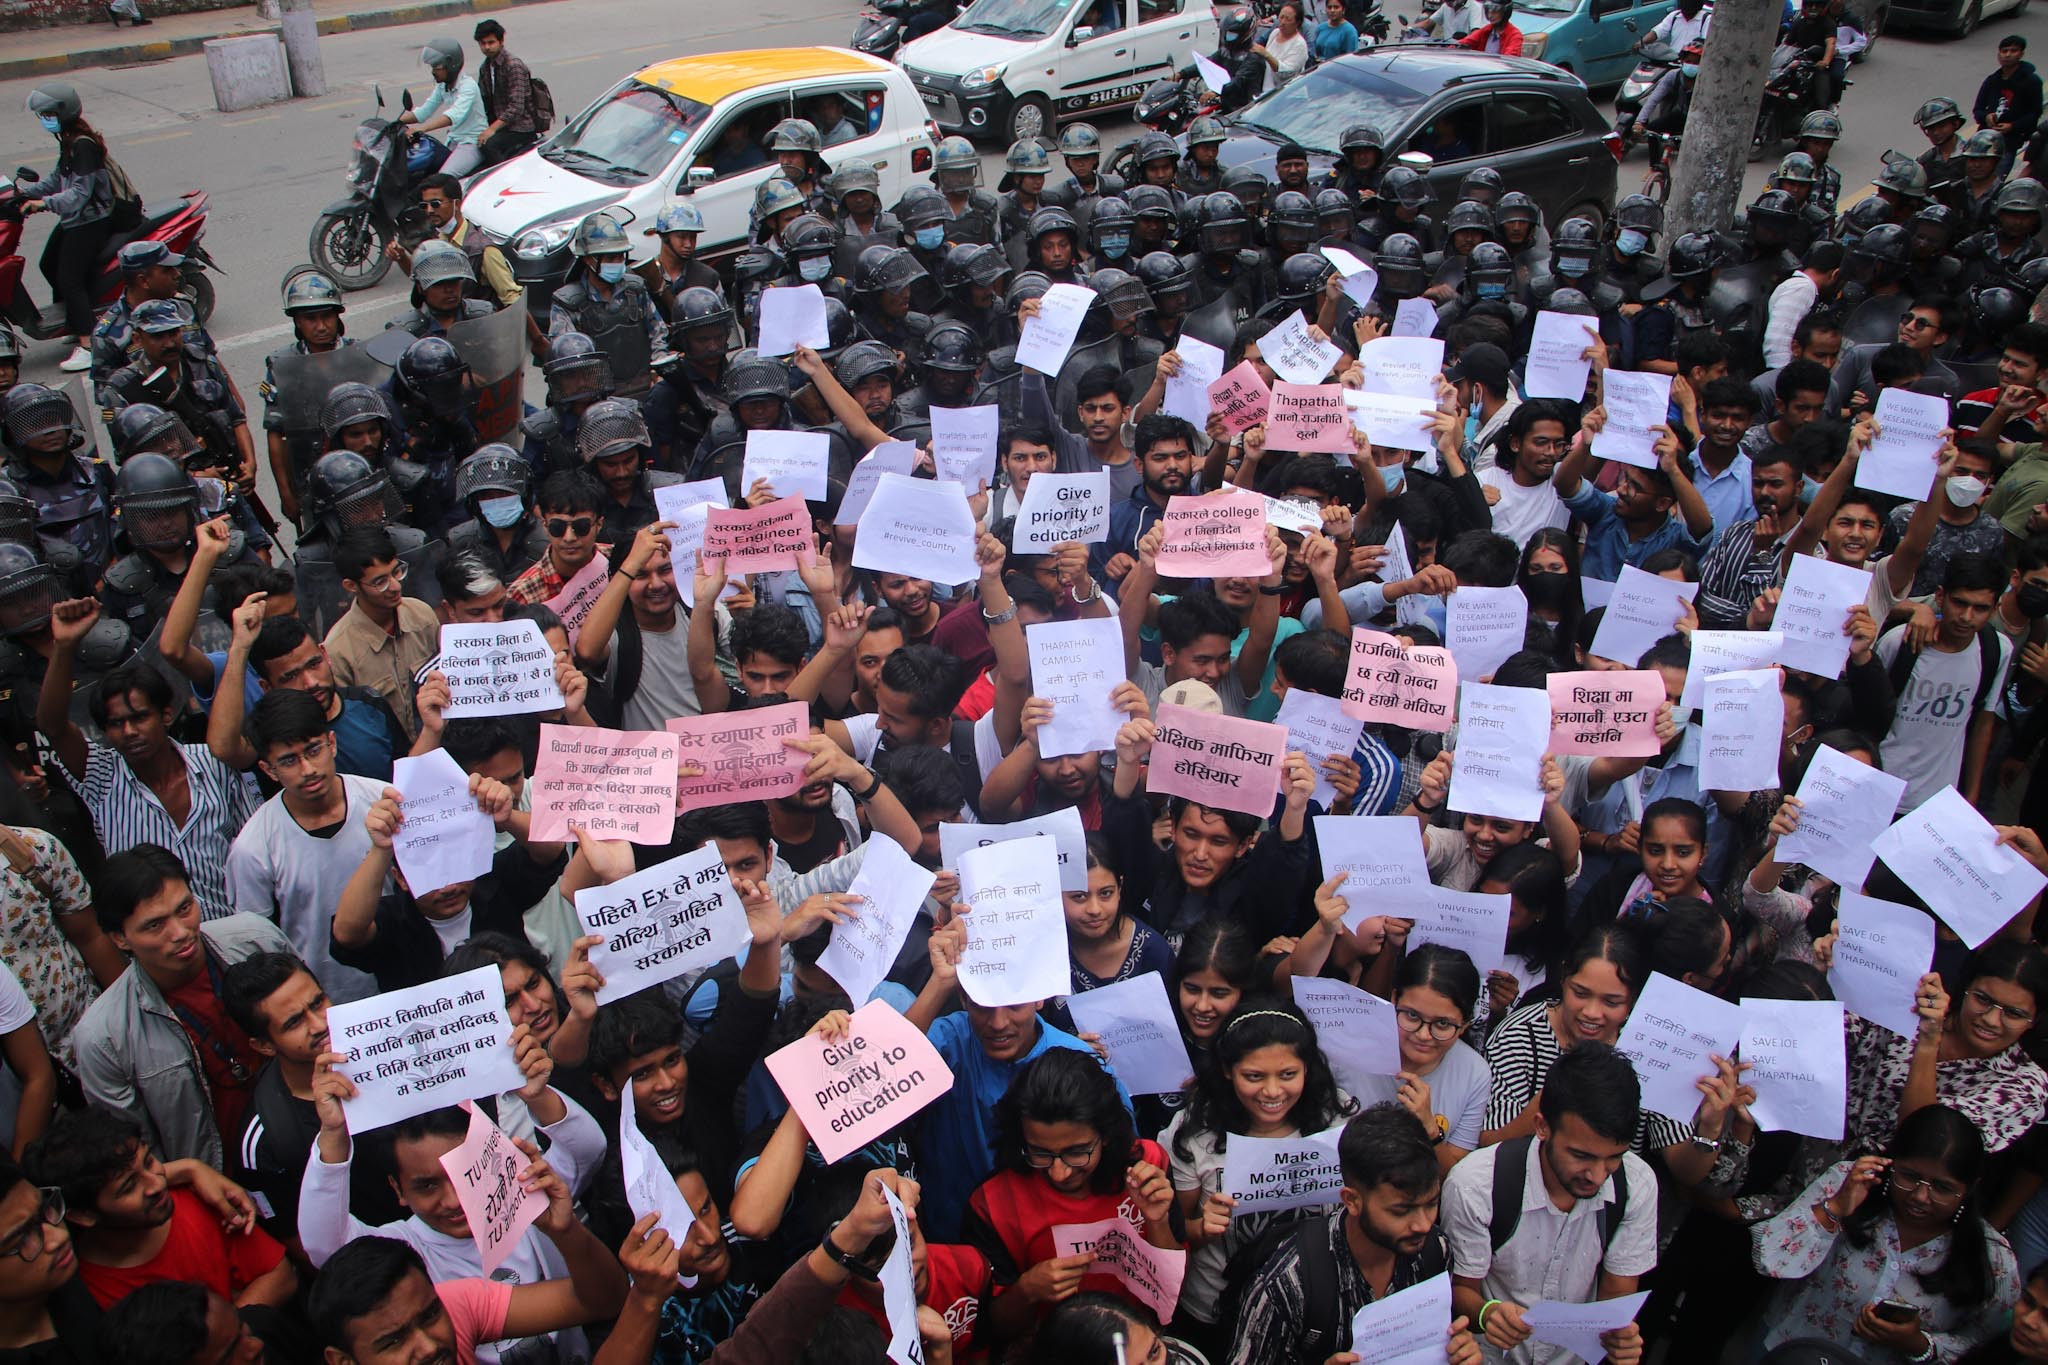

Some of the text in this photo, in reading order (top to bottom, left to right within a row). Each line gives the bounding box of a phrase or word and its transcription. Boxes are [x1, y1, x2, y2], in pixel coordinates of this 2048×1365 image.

[1290, 322, 1329, 361] Thapathali
[1276, 393, 1344, 409] Thapathali
[1901, 406, 1925, 416] WANT
[1057, 487, 1092, 501] Give
[1031, 505, 1104, 526] priority to
[1166, 508, 1209, 520] सरकारले
[1212, 505, 1260, 520] college
[735, 528, 802, 544] Engineer
[894, 520, 950, 538] #revive_IOE
[1030, 523, 1100, 542] education
[884, 532, 957, 555] #revive_country
[1456, 602, 1497, 610] WE WANT
[1456, 611, 1518, 621] RESEARCH AND
[1456, 623, 1516, 632] DEVELOPMENT
[453, 630, 533, 648] सरकार हो
[1040, 638, 1096, 651] THAPATHALI
[1456, 635, 1488, 644] GRANTS
[1041, 655, 1082, 666] CAMPUS
[1414, 653, 1445, 668] कालो
[1357, 667, 1439, 690] छ त्यो भन्दा
[1573, 687, 1633, 704] शिक्षा मा
[1403, 698, 1447, 717] भविष्य
[1713, 701, 1749, 713] होसियार
[1468, 716, 1505, 730] होसियार
[1555, 709, 1649, 724] लगानी एउटा
[712, 727, 766, 744] व्यापार
[1573, 728, 1624, 744] कहानि
[662, 747, 673, 759] हो
[1209, 742, 1275, 767] माफिया
[1708, 746, 1744, 758] होसियार
[566, 761, 578, 773] कि
[581, 764, 630, 776] आन्दोलन
[1174, 759, 1243, 787] होसियार
[1463, 765, 1501, 779] होसियार
[544, 781, 565, 792] भयो
[568, 783, 584, 792] मन
[606, 782, 636, 796] विदेश
[398, 786, 457, 811] Engineer को
[440, 808, 457, 821] देश
[461, 802, 475, 814] को
[550, 801, 661, 815] तर लाखको
[406, 833, 441, 850] भविष्य
[1333, 863, 1406, 873] GIVE PRIORITY
[1353, 876, 1412, 887] EDUCATION
[1012, 883, 1042, 897] कालो
[586, 874, 693, 929] पहिले Ex ले
[1437, 902, 1495, 916] UNIVERSITY
[1005, 910, 1036, 924] भन्दा
[1842, 925, 1888, 944] SAVE IOE
[634, 927, 712, 971] सरकारले
[1840, 940, 1865, 954] SAVE
[968, 962, 1007, 975] भविष्य
[1839, 952, 1898, 978] THAPATHALI
[344, 990, 487, 1039] सरकार तिमीपनि मौन
[1306, 1007, 1372, 1015] KOTESHWOR
[1115, 1020, 1156, 1036] PRIORITY
[1323, 1020, 1345, 1030] JAM
[1643, 1013, 1720, 1048] राजनिति कालो
[365, 1036, 404, 1058] मपनि
[408, 1028, 437, 1045] मौन
[1110, 1033, 1159, 1049] EDUCATION
[1751, 1040, 1799, 1050] SAVE IOE
[822, 1036, 868, 1067] Give
[1671, 1045, 1700, 1061] भन्दा
[353, 1034, 498, 1087] तर तिमि दरबारमा बस
[1751, 1058, 1777, 1069] SAVE
[397, 1067, 467, 1097] म सडकमा
[815, 1046, 906, 1110] priority to
[1752, 1071, 1815, 1085] THAPATHALI
[830, 1070, 925, 1133] education
[1274, 1150, 1320, 1165] Make
[464, 1167, 482, 1188] TU
[1250, 1164, 1342, 1185] Monitoring
[1232, 1188, 1285, 1201] Policy
[487, 1187, 527, 1249] TU airport
